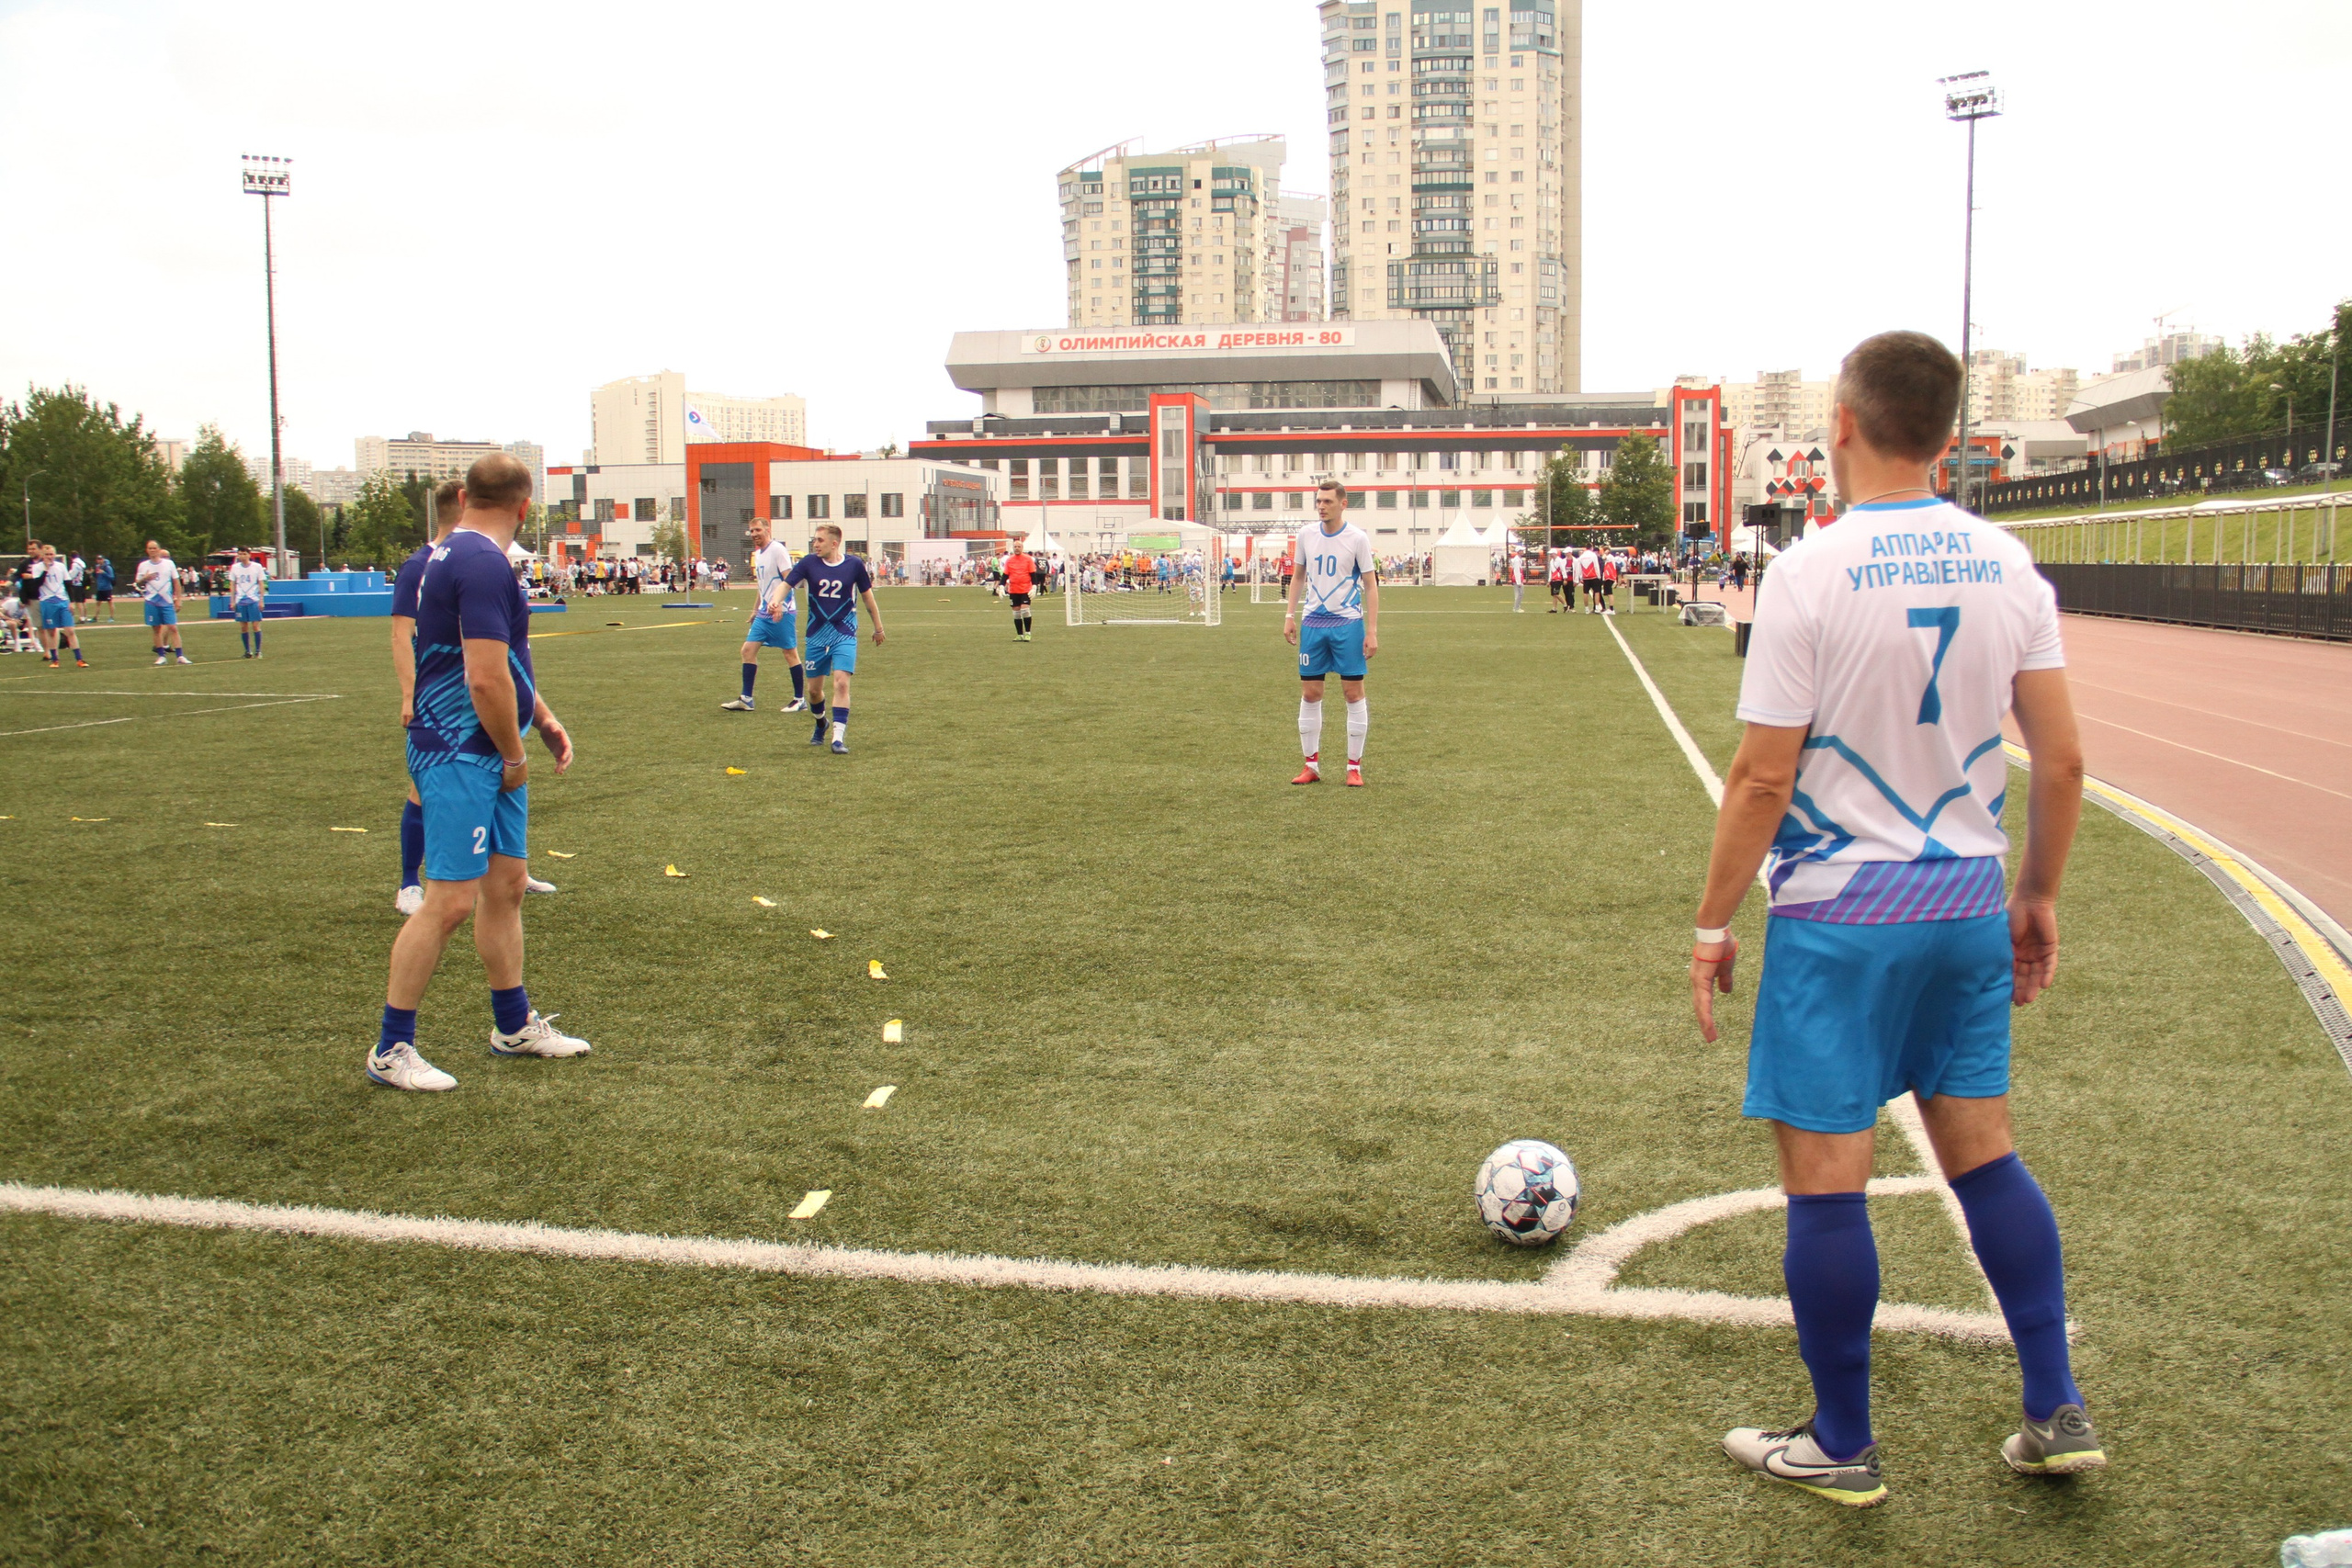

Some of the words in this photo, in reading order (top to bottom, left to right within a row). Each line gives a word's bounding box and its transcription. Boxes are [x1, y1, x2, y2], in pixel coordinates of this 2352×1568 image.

[1059, 333, 1205, 351] ОЛИМПИЙСКАЯ
[1218, 333, 1304, 349] ДЕРЕВНЯ
[1319, 332, 1341, 344] 80
[1871, 531, 1973, 558] АППАРАТ
[1315, 554, 1337, 577] 10
[1847, 559, 2003, 592] УПРАВЛЕНИЯ
[819, 579, 843, 599] 22
[805, 660, 816, 671] 22
[1299, 653, 1309, 666] 10
[1906, 606, 1961, 726] 7
[472, 826, 487, 854] 2
